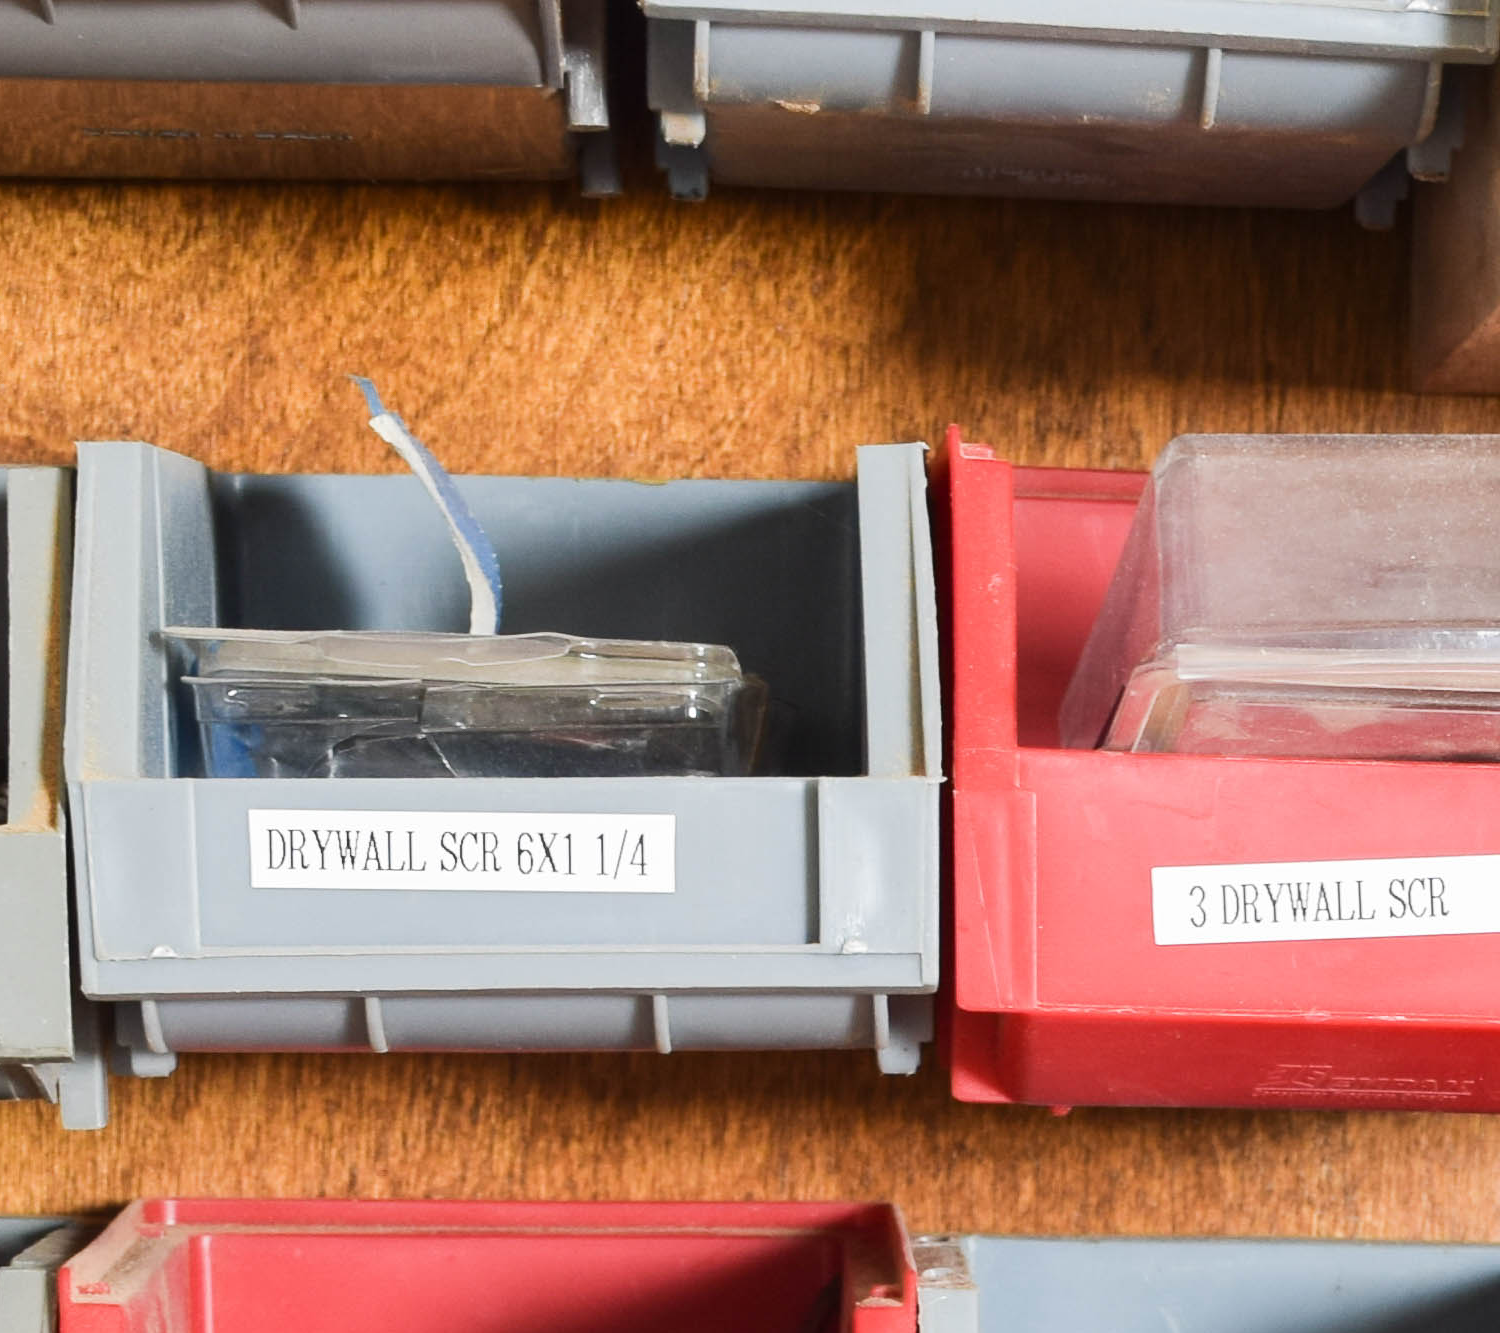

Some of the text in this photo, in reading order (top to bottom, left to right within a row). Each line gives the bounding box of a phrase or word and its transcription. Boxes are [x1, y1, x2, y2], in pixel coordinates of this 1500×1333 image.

[267, 828, 647, 880] DRYWALL SCR 6X1 1/4
[1189, 877, 1450, 928] 3 DRYWALL SCR
